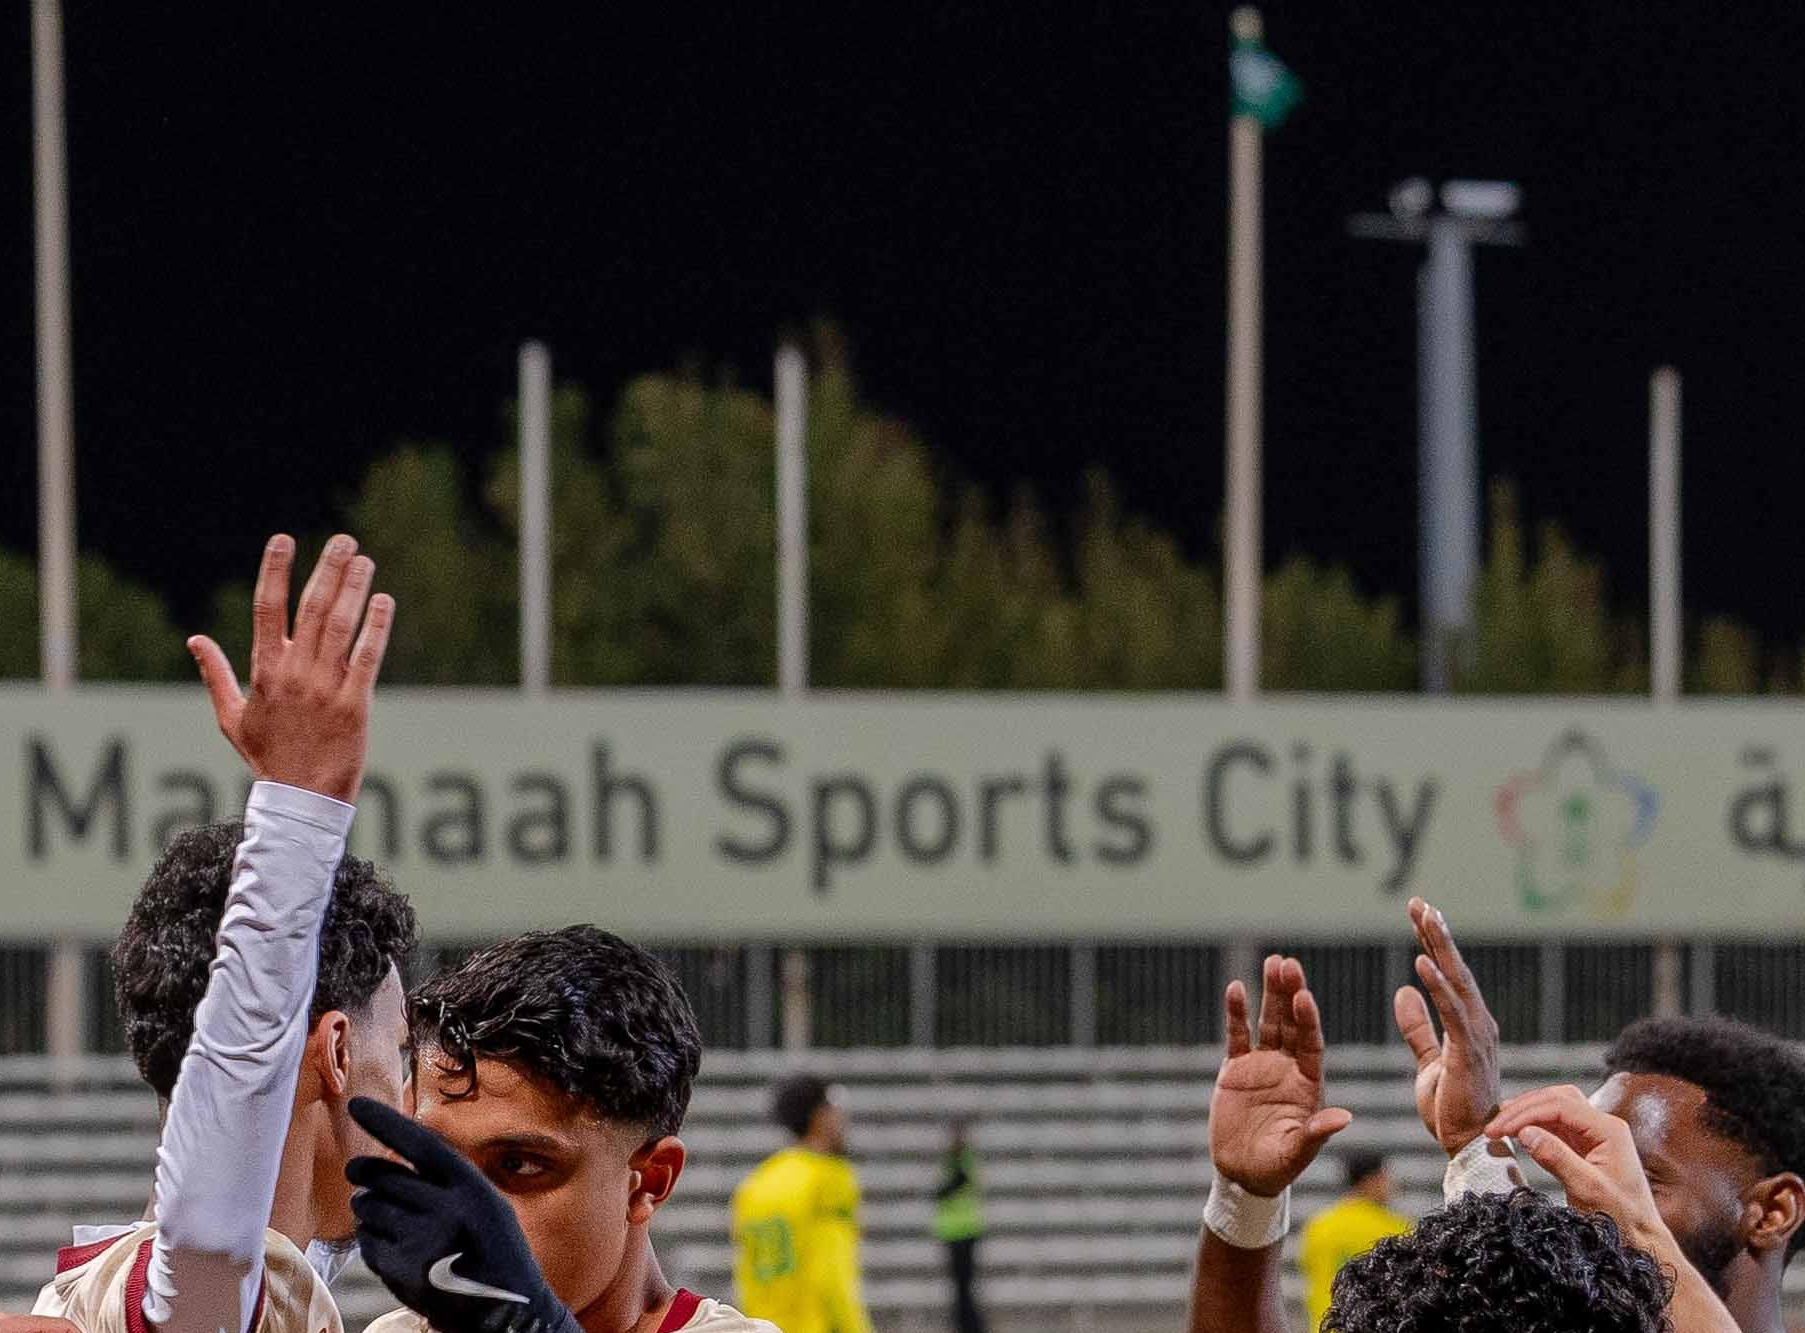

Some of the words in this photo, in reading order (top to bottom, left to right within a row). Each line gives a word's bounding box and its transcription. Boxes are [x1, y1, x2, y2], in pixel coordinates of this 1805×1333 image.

[24, 735, 662, 868] Maaah
[714, 738, 1155, 896] Sports
[1202, 740, 1438, 892] City
